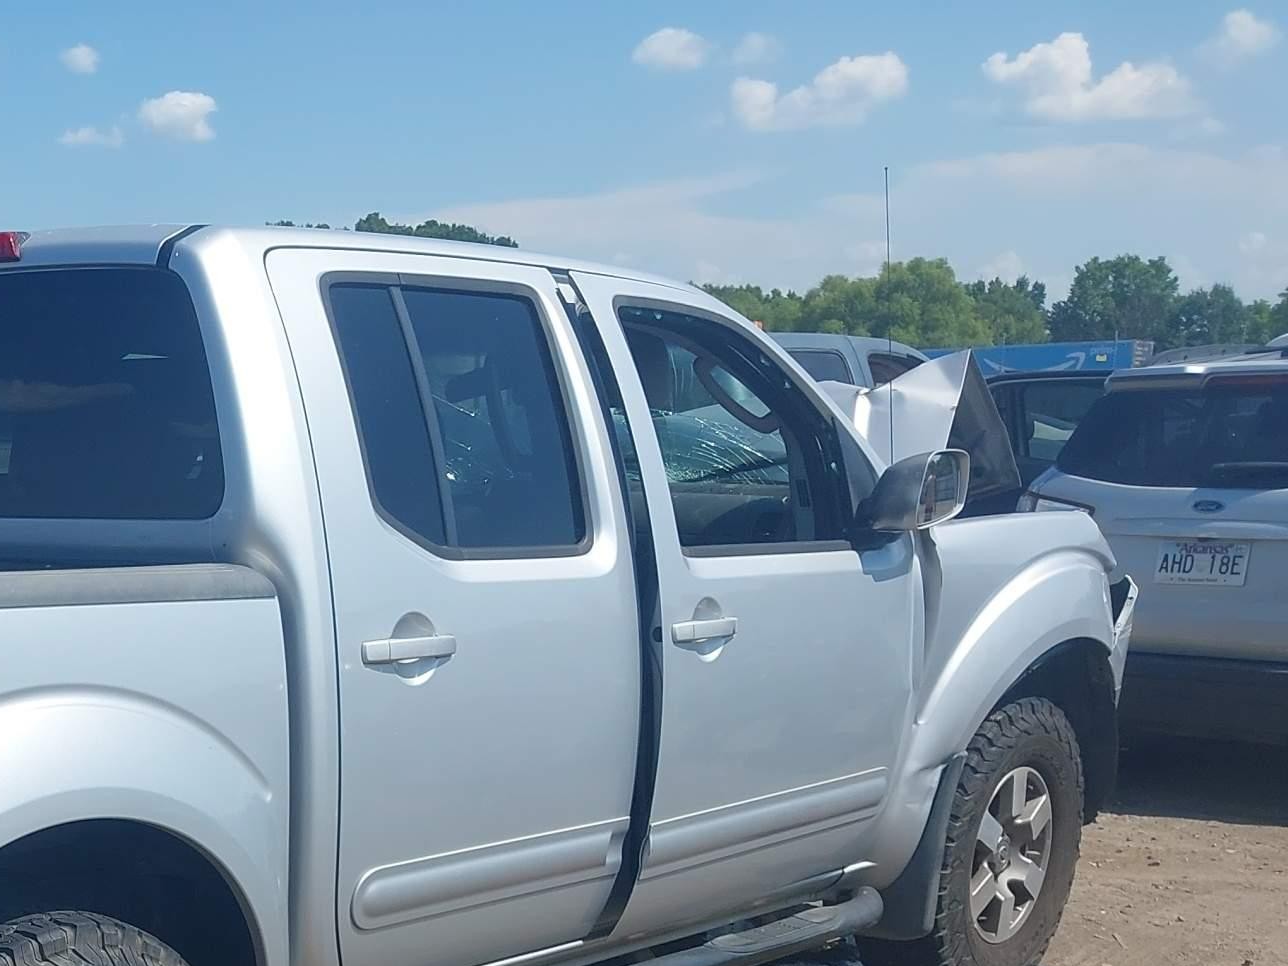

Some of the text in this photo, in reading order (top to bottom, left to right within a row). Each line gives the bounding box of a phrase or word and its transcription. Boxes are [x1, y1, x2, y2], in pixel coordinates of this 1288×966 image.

[1180, 543, 1232, 555] Arkansas
[1158, 553, 1244, 575] AHD 18E
